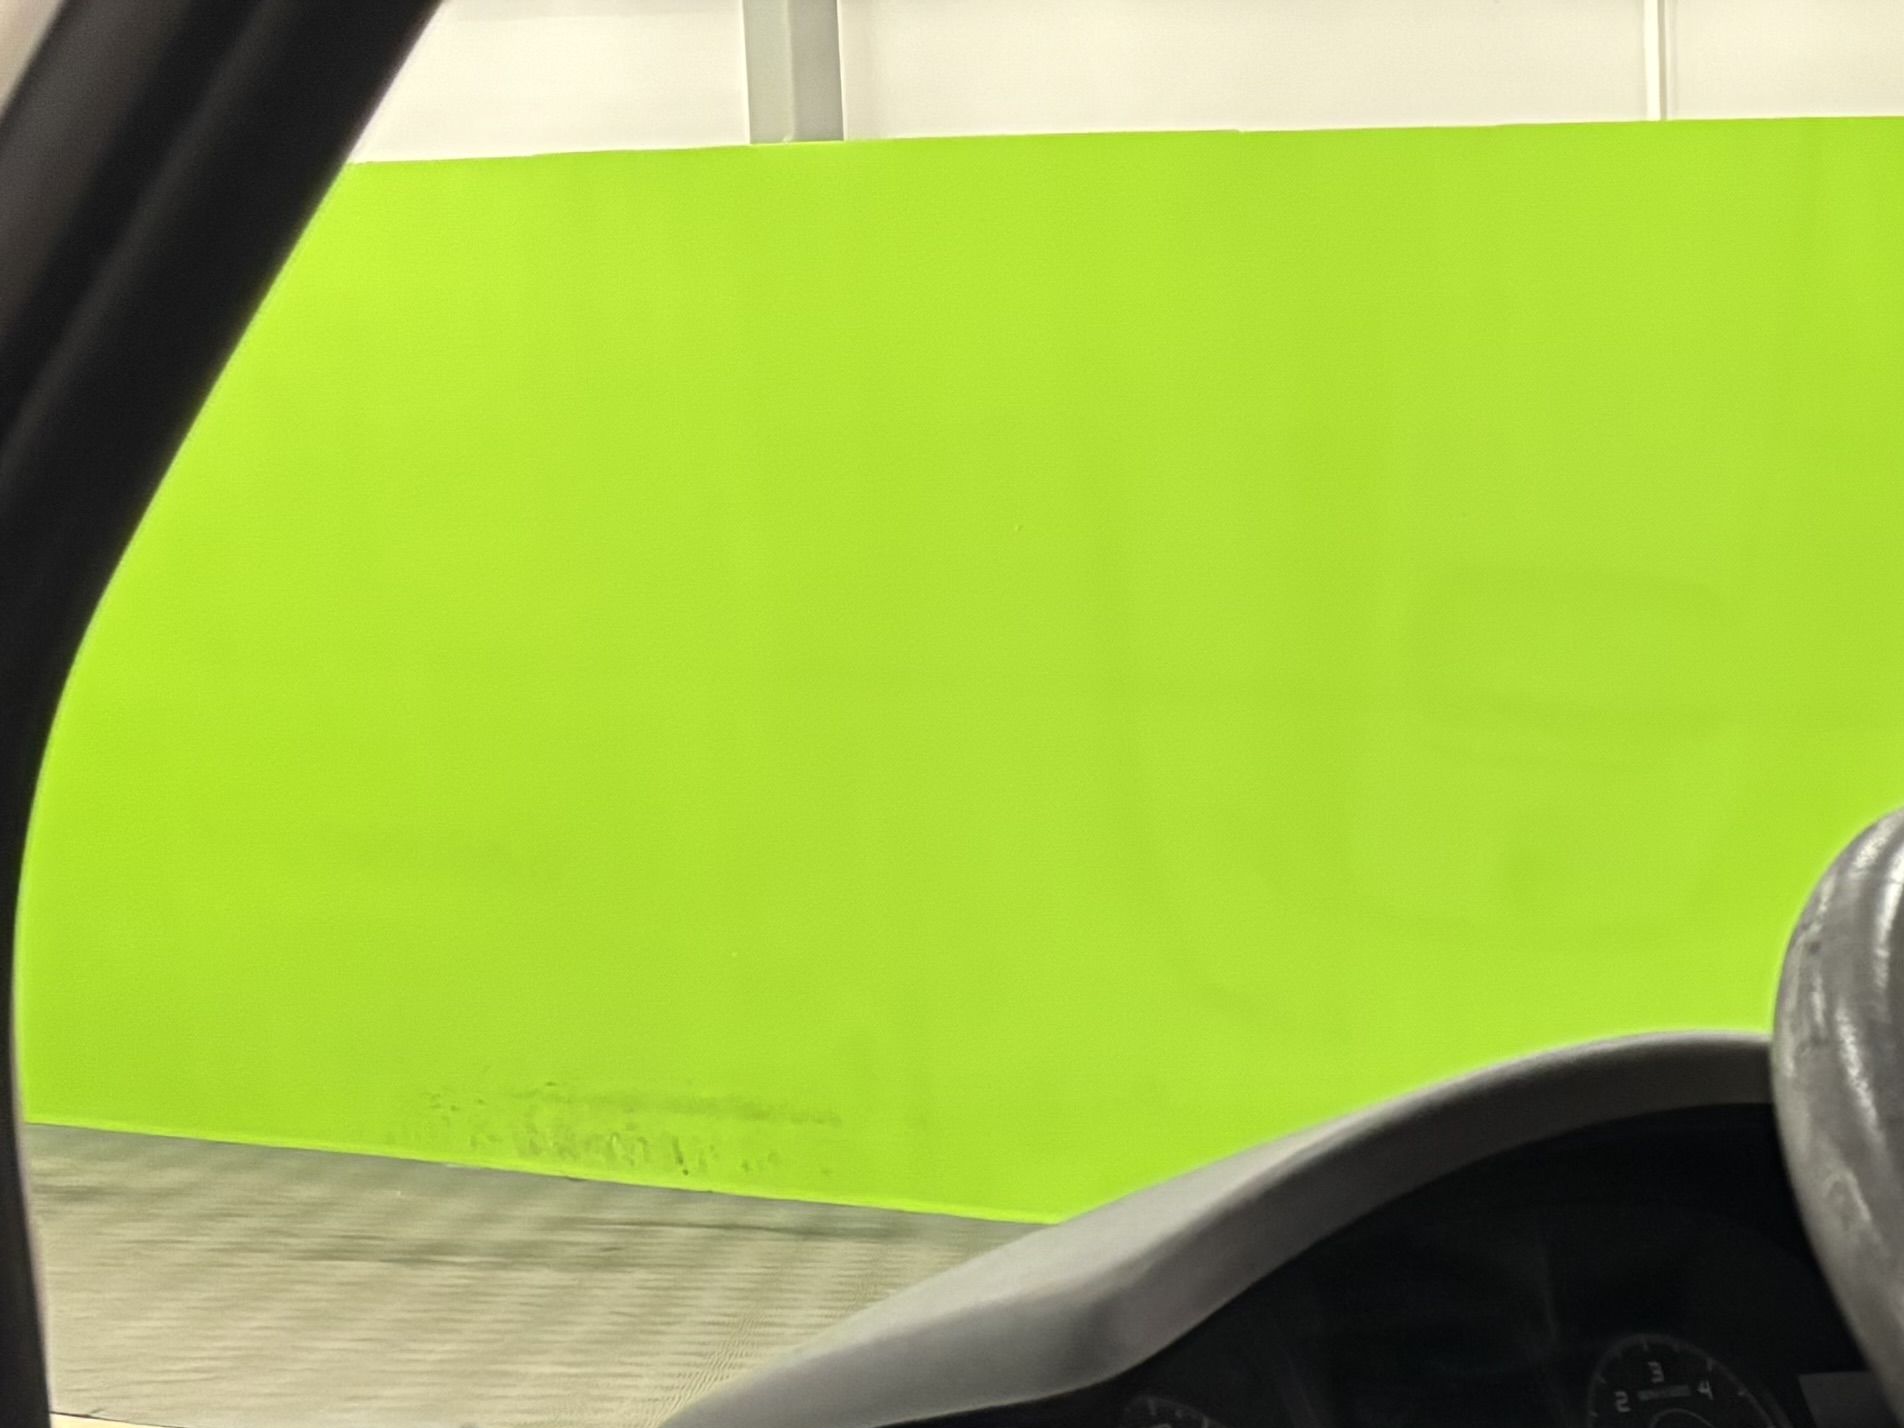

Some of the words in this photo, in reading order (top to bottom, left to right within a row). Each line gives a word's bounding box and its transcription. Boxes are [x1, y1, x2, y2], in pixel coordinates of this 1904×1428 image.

[1647, 1361, 1665, 1384] 3
[1613, 1390, 1631, 1413] 2
[1696, 1379, 1714, 1401] 4
